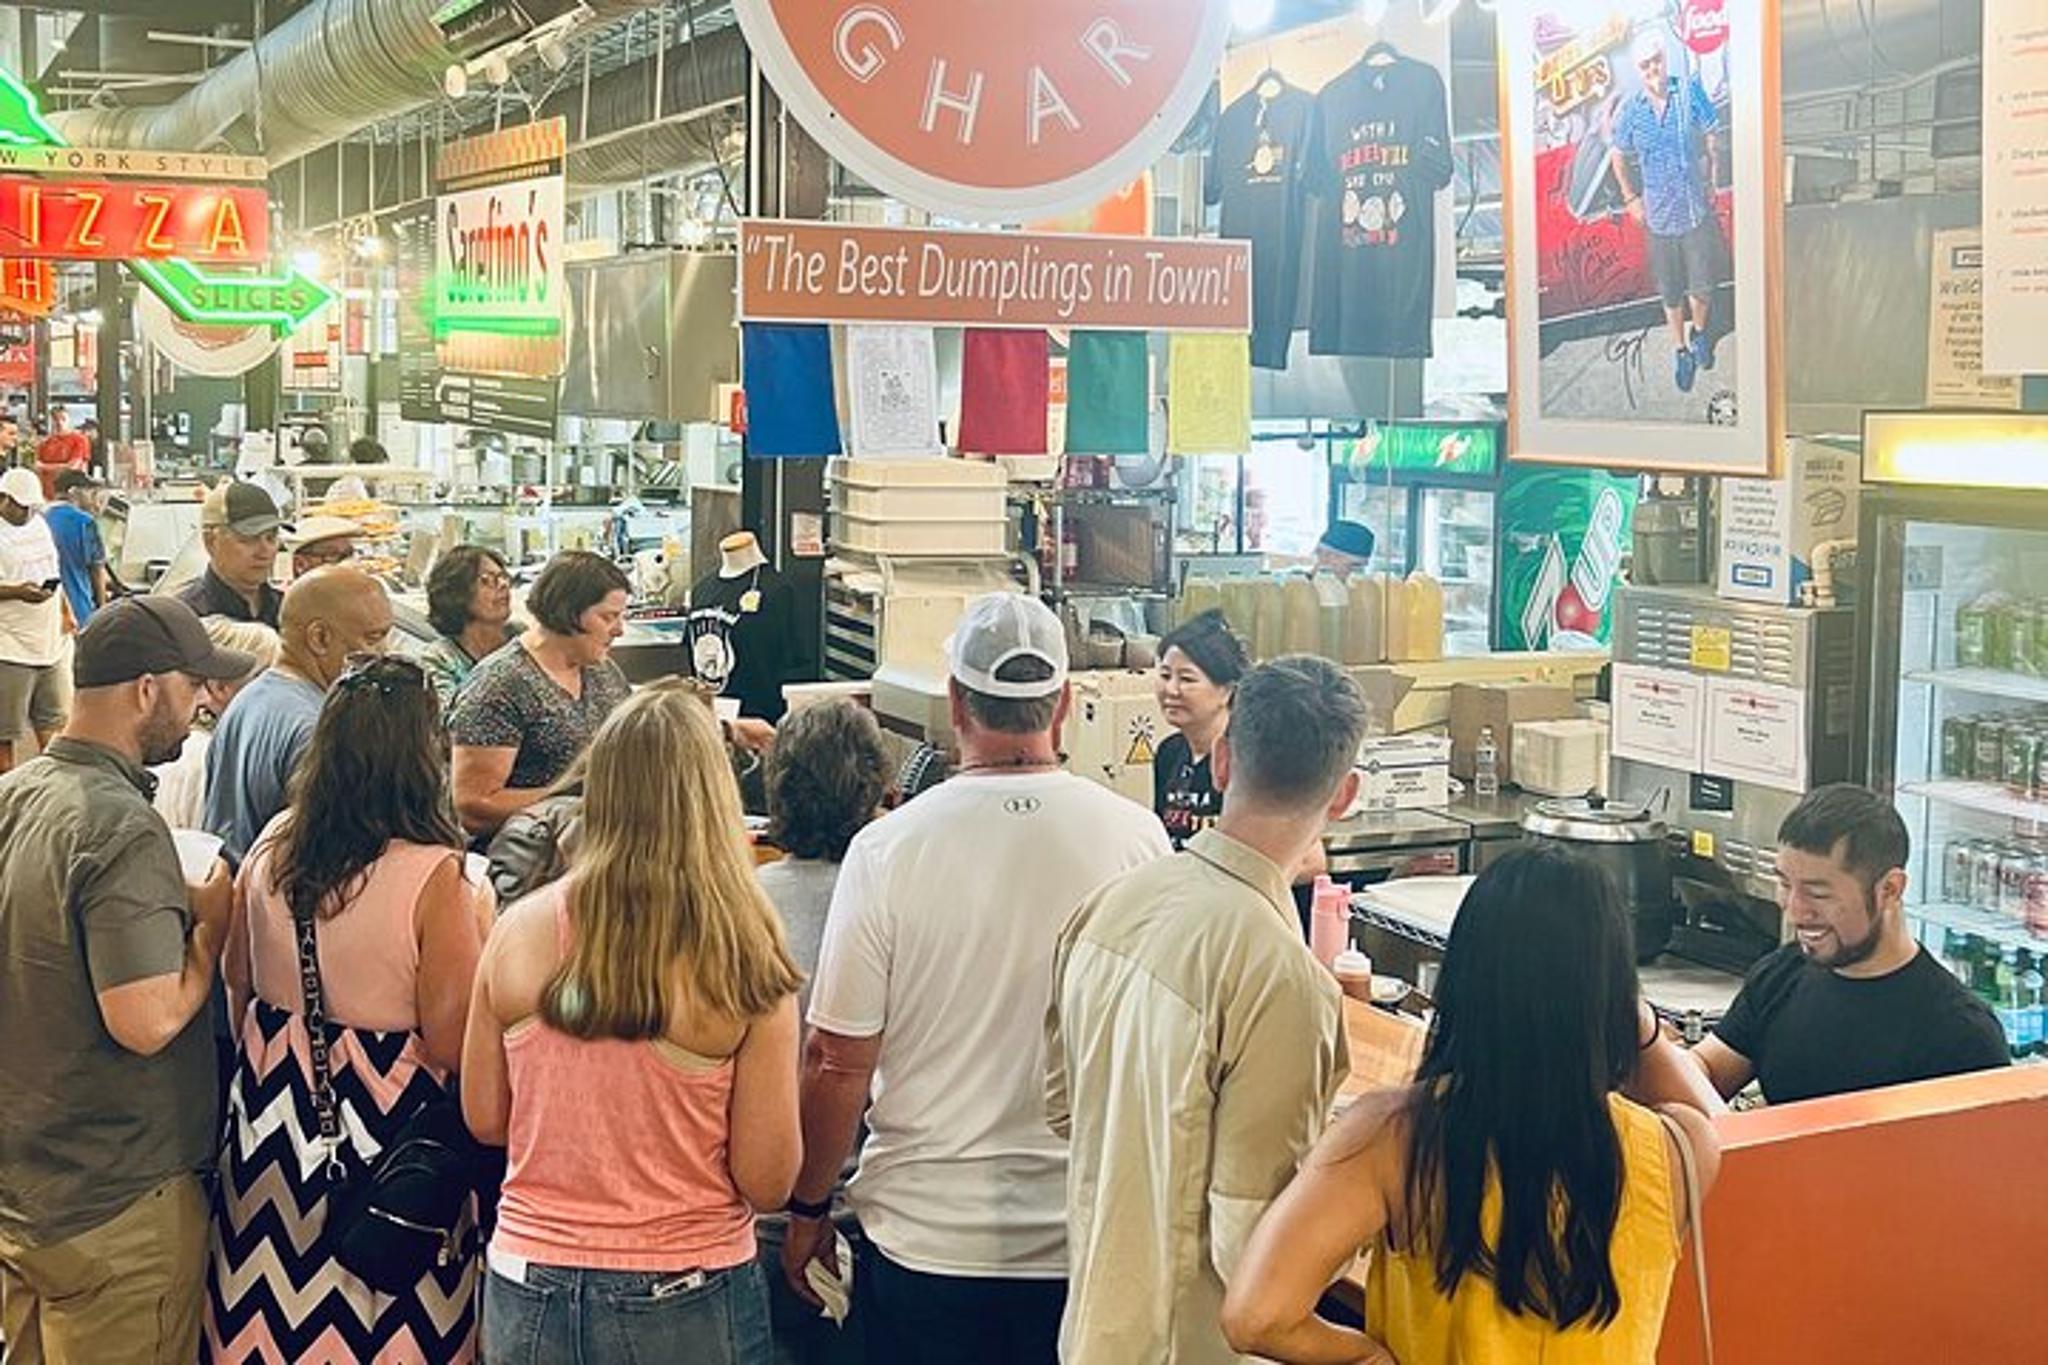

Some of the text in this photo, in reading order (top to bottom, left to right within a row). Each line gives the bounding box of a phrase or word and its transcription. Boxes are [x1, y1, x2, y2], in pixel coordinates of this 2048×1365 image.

[833, 5, 1151, 145] GHAR
[45, 151, 132, 169] YORK
[157, 157, 257, 174] STYLE
[190, 286, 307, 311] SLICES
[747, 233, 1248, 317] "The Best Dumplings in Town!"
